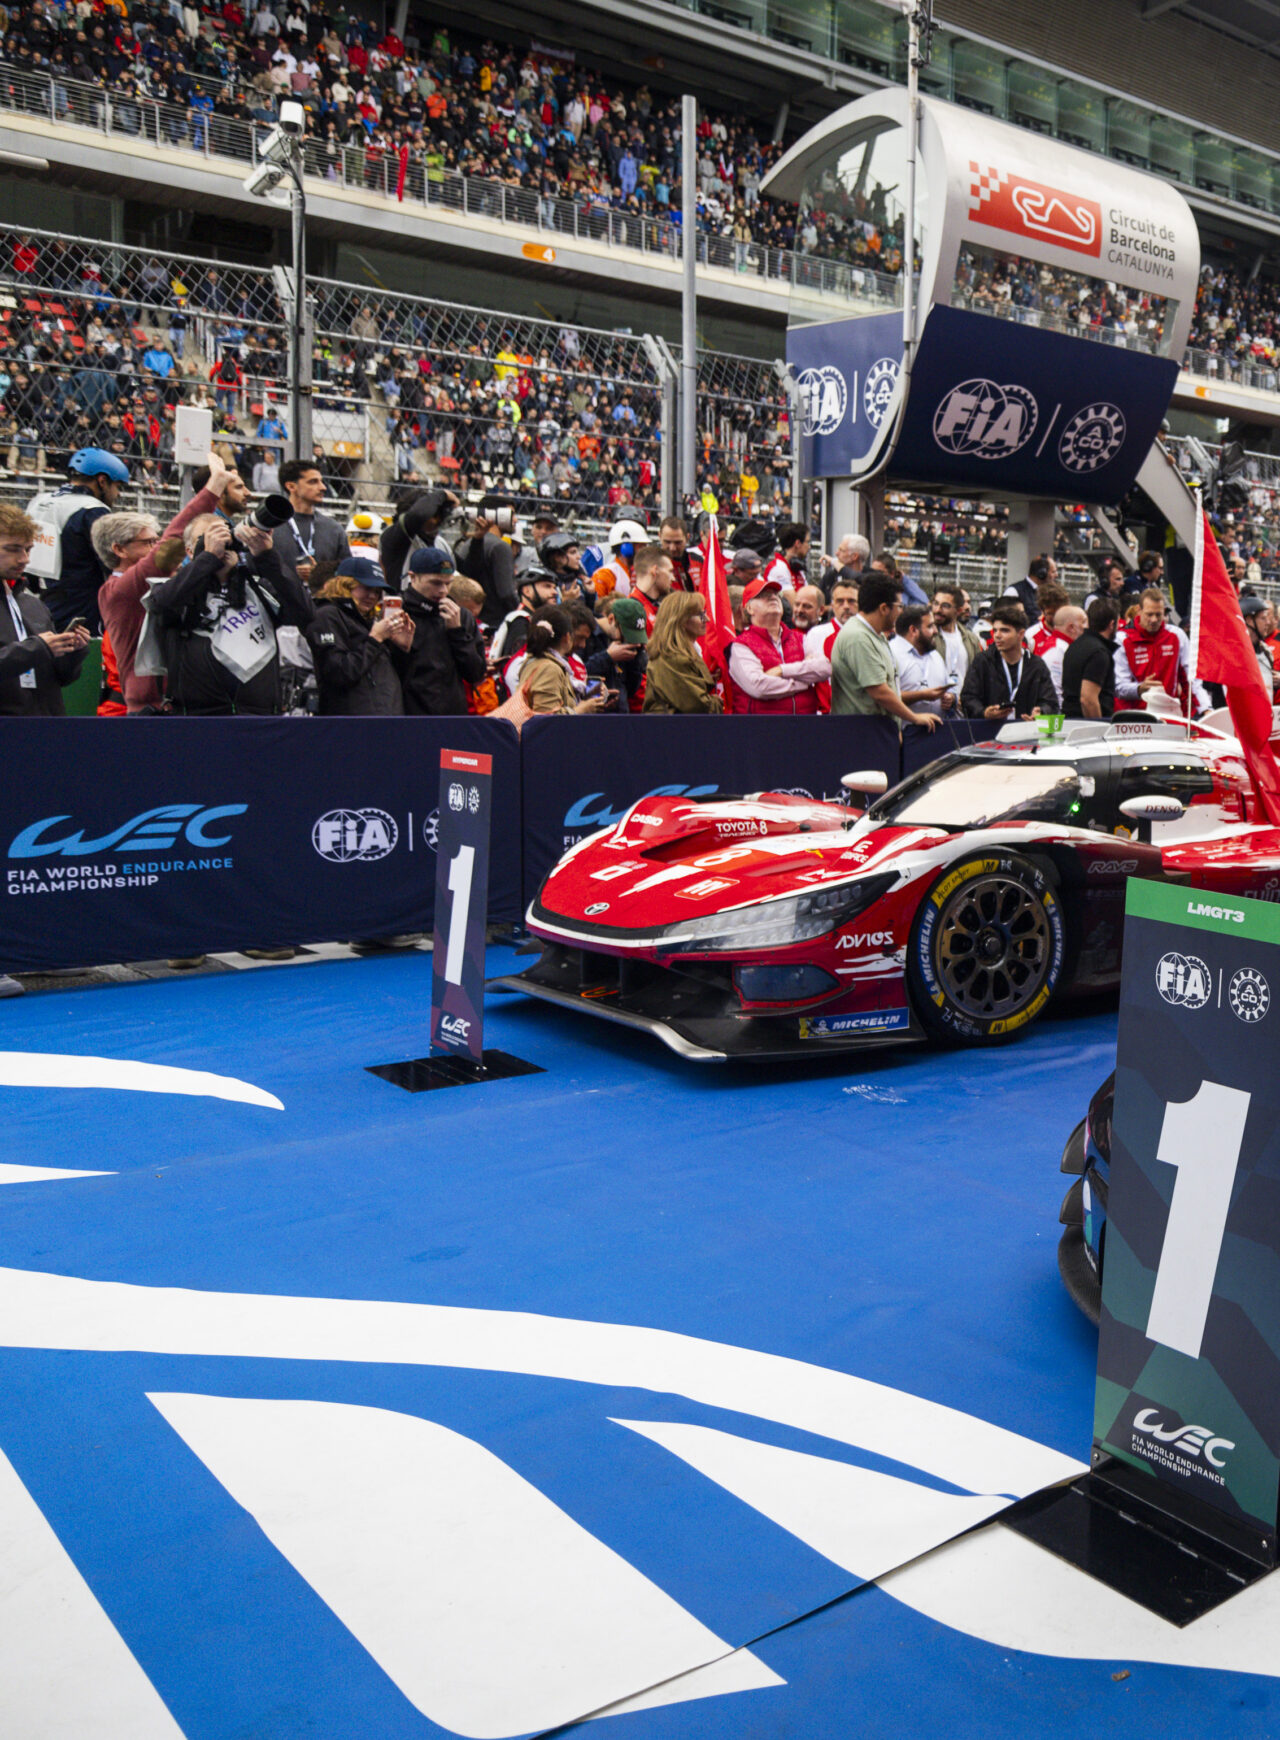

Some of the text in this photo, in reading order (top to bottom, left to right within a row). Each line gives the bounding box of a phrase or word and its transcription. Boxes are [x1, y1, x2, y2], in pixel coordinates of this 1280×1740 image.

[1109, 209, 1175, 243] Circuit de
[1110, 228, 1176, 261] Barcelona
[1108, 249, 1175, 280] CATALUNYA
[1115, 724, 1153, 735] TOYOTA
[630, 813, 663, 827] CASIO
[1144, 804, 1181, 814] DENSO
[8, 803, 249, 859] WEC
[715, 819, 768, 836] TOYOTA 8
[8, 858, 234, 882] FIA WORLD ENDURANCE
[1087, 860, 1139, 874] RAYS
[8, 874, 159, 895] CHAMPIONSHIP
[444, 844, 476, 987] 1
[1187, 901, 1245, 922] LMGT3
[919, 908, 936, 981] MICHELIN
[1052, 916, 1063, 984] MICHELIN
[440, 1015, 472, 1037] WEC
[832, 1014, 901, 1031] MICHELIN
[1145, 1079, 1252, 1360] 1
[1133, 1408, 1236, 1468] WEC
[1131, 1443, 1192, 1477] CHAMPIONSHIP
[1131, 1434, 1226, 1487] FIA WORLD ENDURANCE
